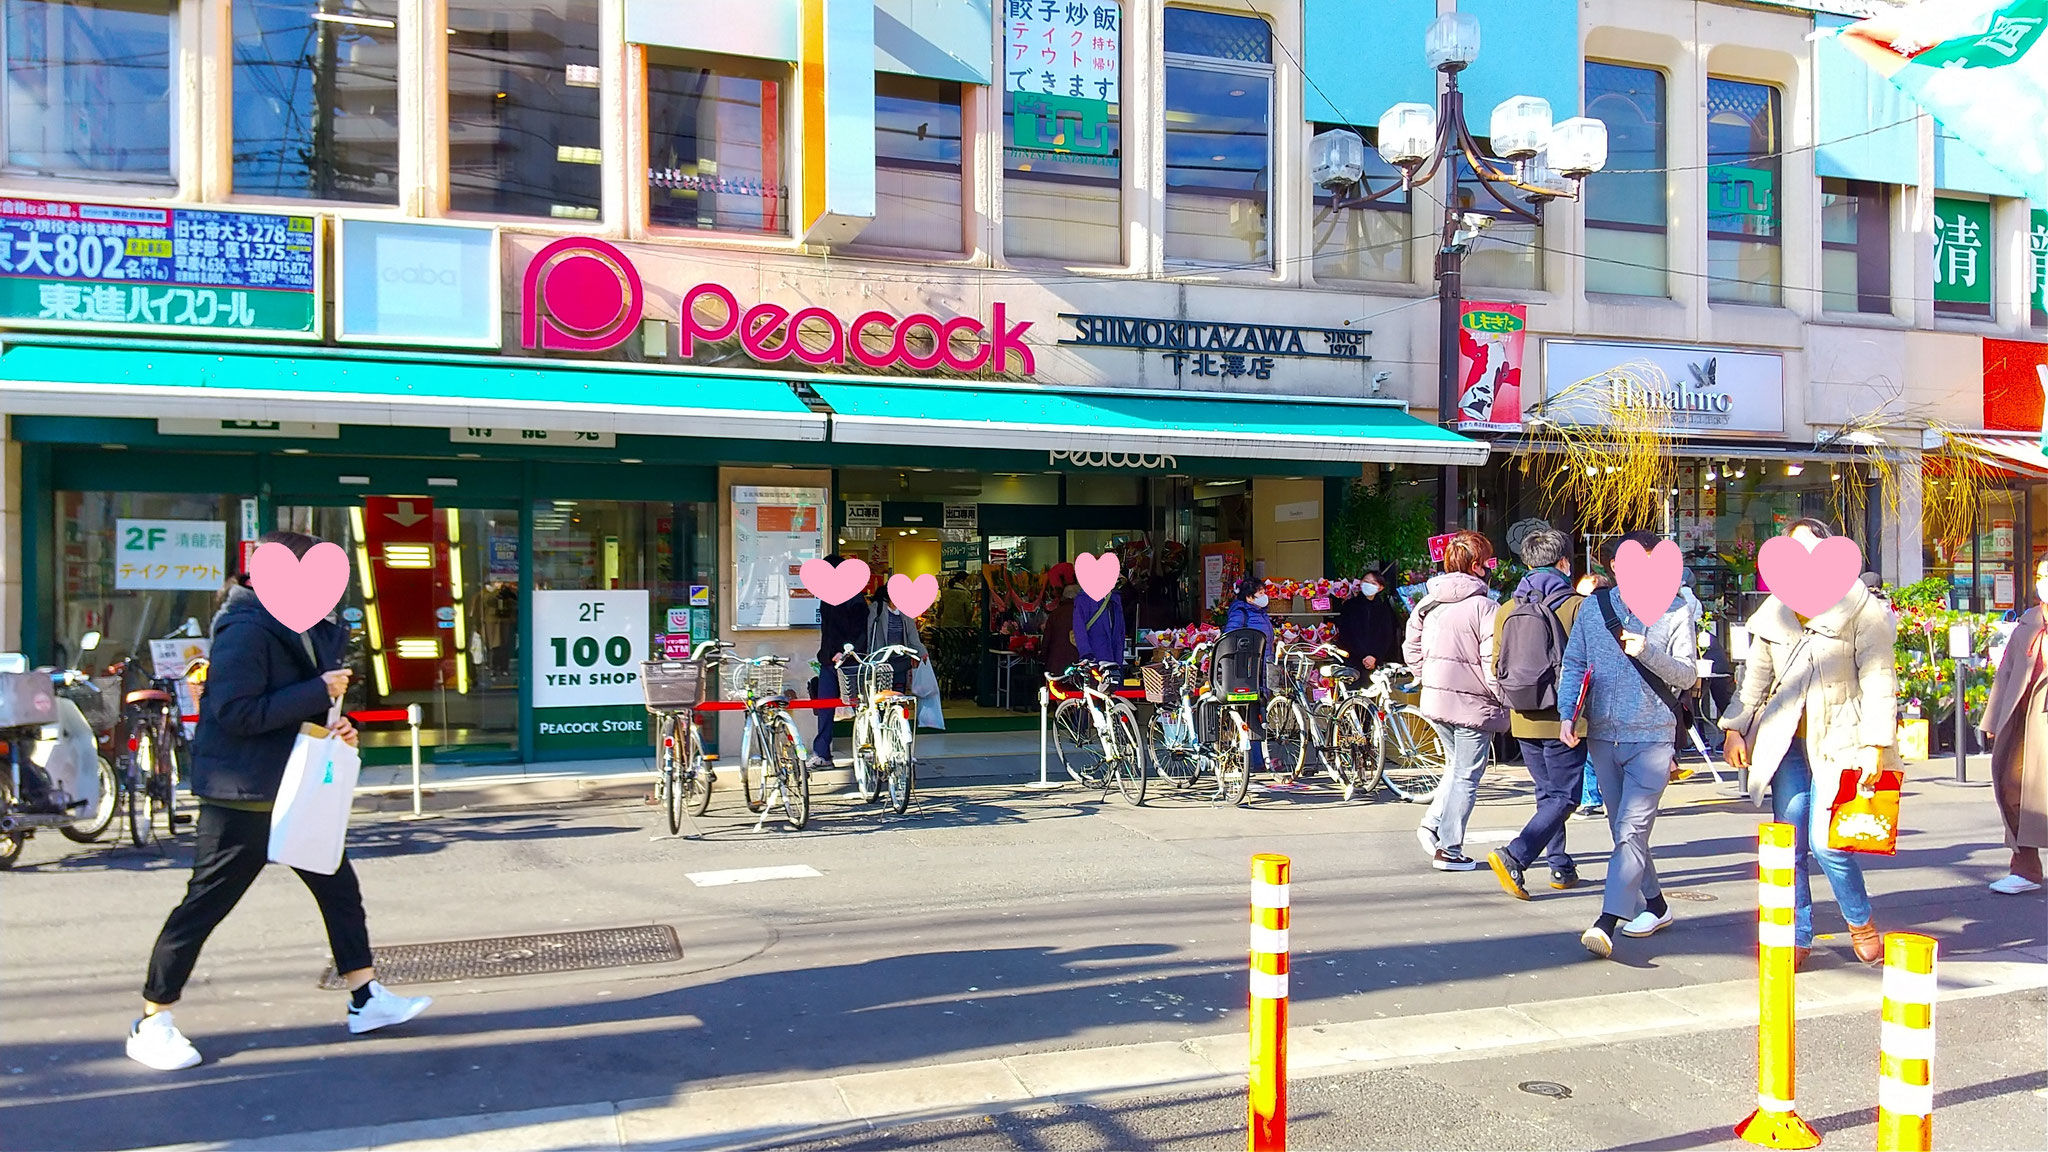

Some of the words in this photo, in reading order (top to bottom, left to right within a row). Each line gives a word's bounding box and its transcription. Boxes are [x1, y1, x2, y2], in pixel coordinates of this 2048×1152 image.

[1009, 67, 1114, 101] できます
[0, 218, 168, 240] 一の現役合格実績を更新
[1934, 214, 1982, 287] 清
[38, 283, 256, 326] 東進ハイスクール
[1469, 312, 1515, 332] しもきた
[1076, 317, 1306, 353] SHIMOKITAZAWA
[1323, 331, 1363, 345] SINCE
[1328, 344, 1358, 356] 1970
[1162, 353, 1275, 380] 下北澤店
[124, 526, 167, 551] 2F
[119, 563, 168, 580] テイク
[174, 563, 222, 581] アウト
[579, 602, 605, 622] 2F
[550, 636, 632, 667] 100
[667, 645, 689, 653] ATM
[546, 673, 582, 686] YEN
[589, 672, 637, 685] SHOP
[539, 722, 600, 735] PEACOCK
[602, 720, 643, 732] STORE
